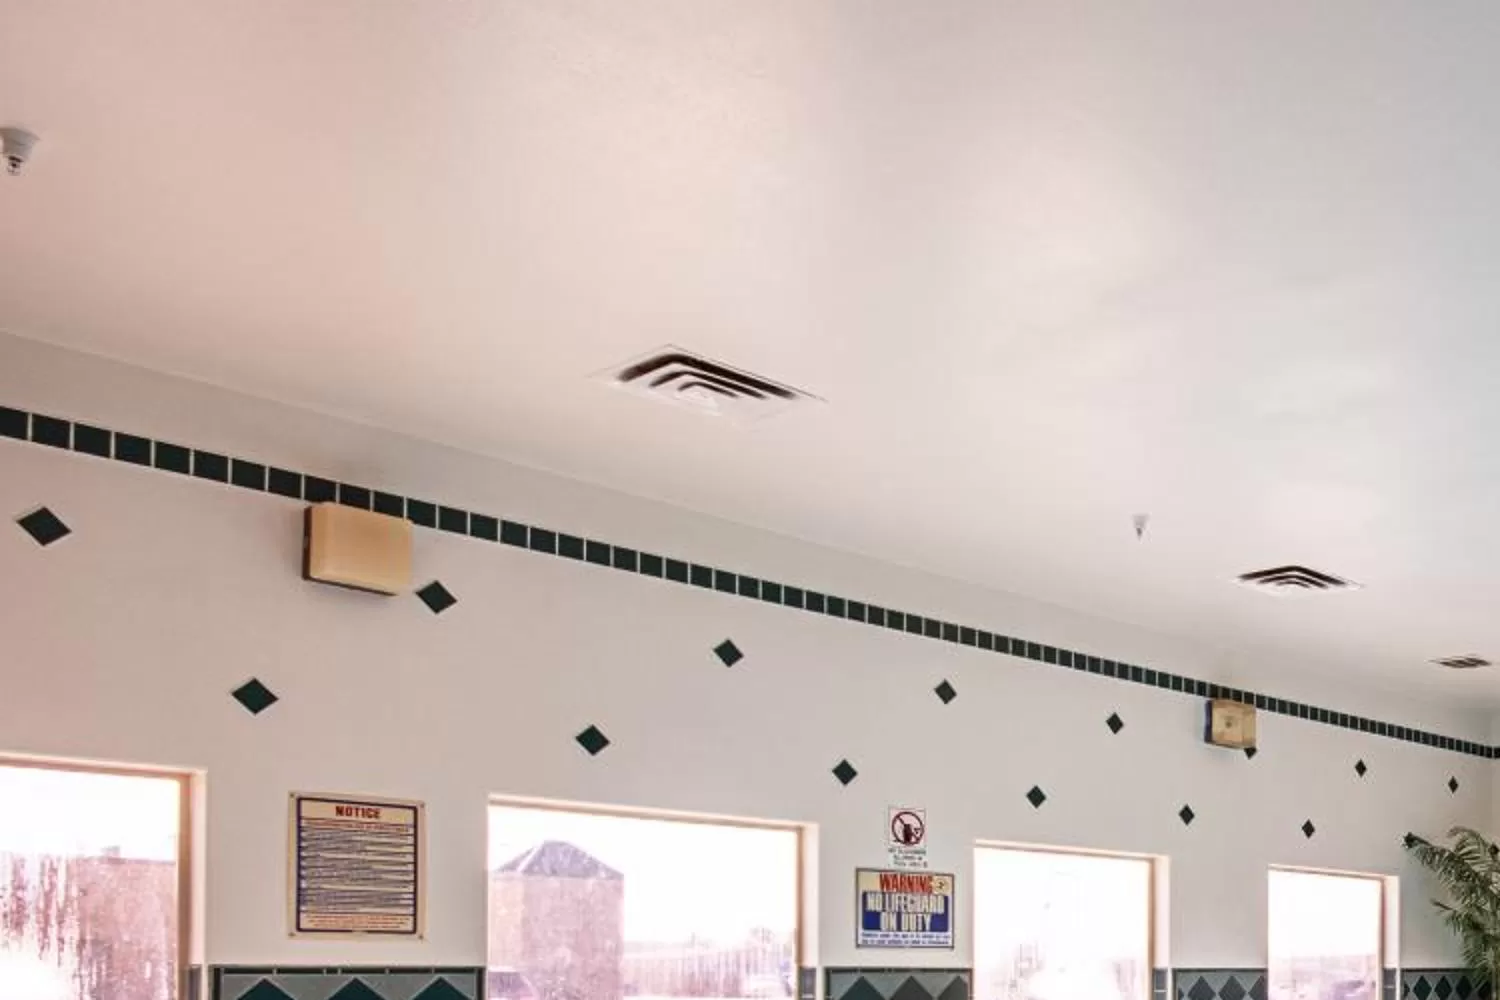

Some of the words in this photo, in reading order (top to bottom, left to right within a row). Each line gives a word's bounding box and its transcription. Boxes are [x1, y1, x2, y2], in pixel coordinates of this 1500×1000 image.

[335, 805, 381, 819] NOTICE
[880, 873, 933, 893] WARNING
[867, 892, 883, 912] NO
[885, 893, 945, 914] LIFEGUARD
[880, 912, 897, 931] ON
[901, 912, 932, 931] DUTY
